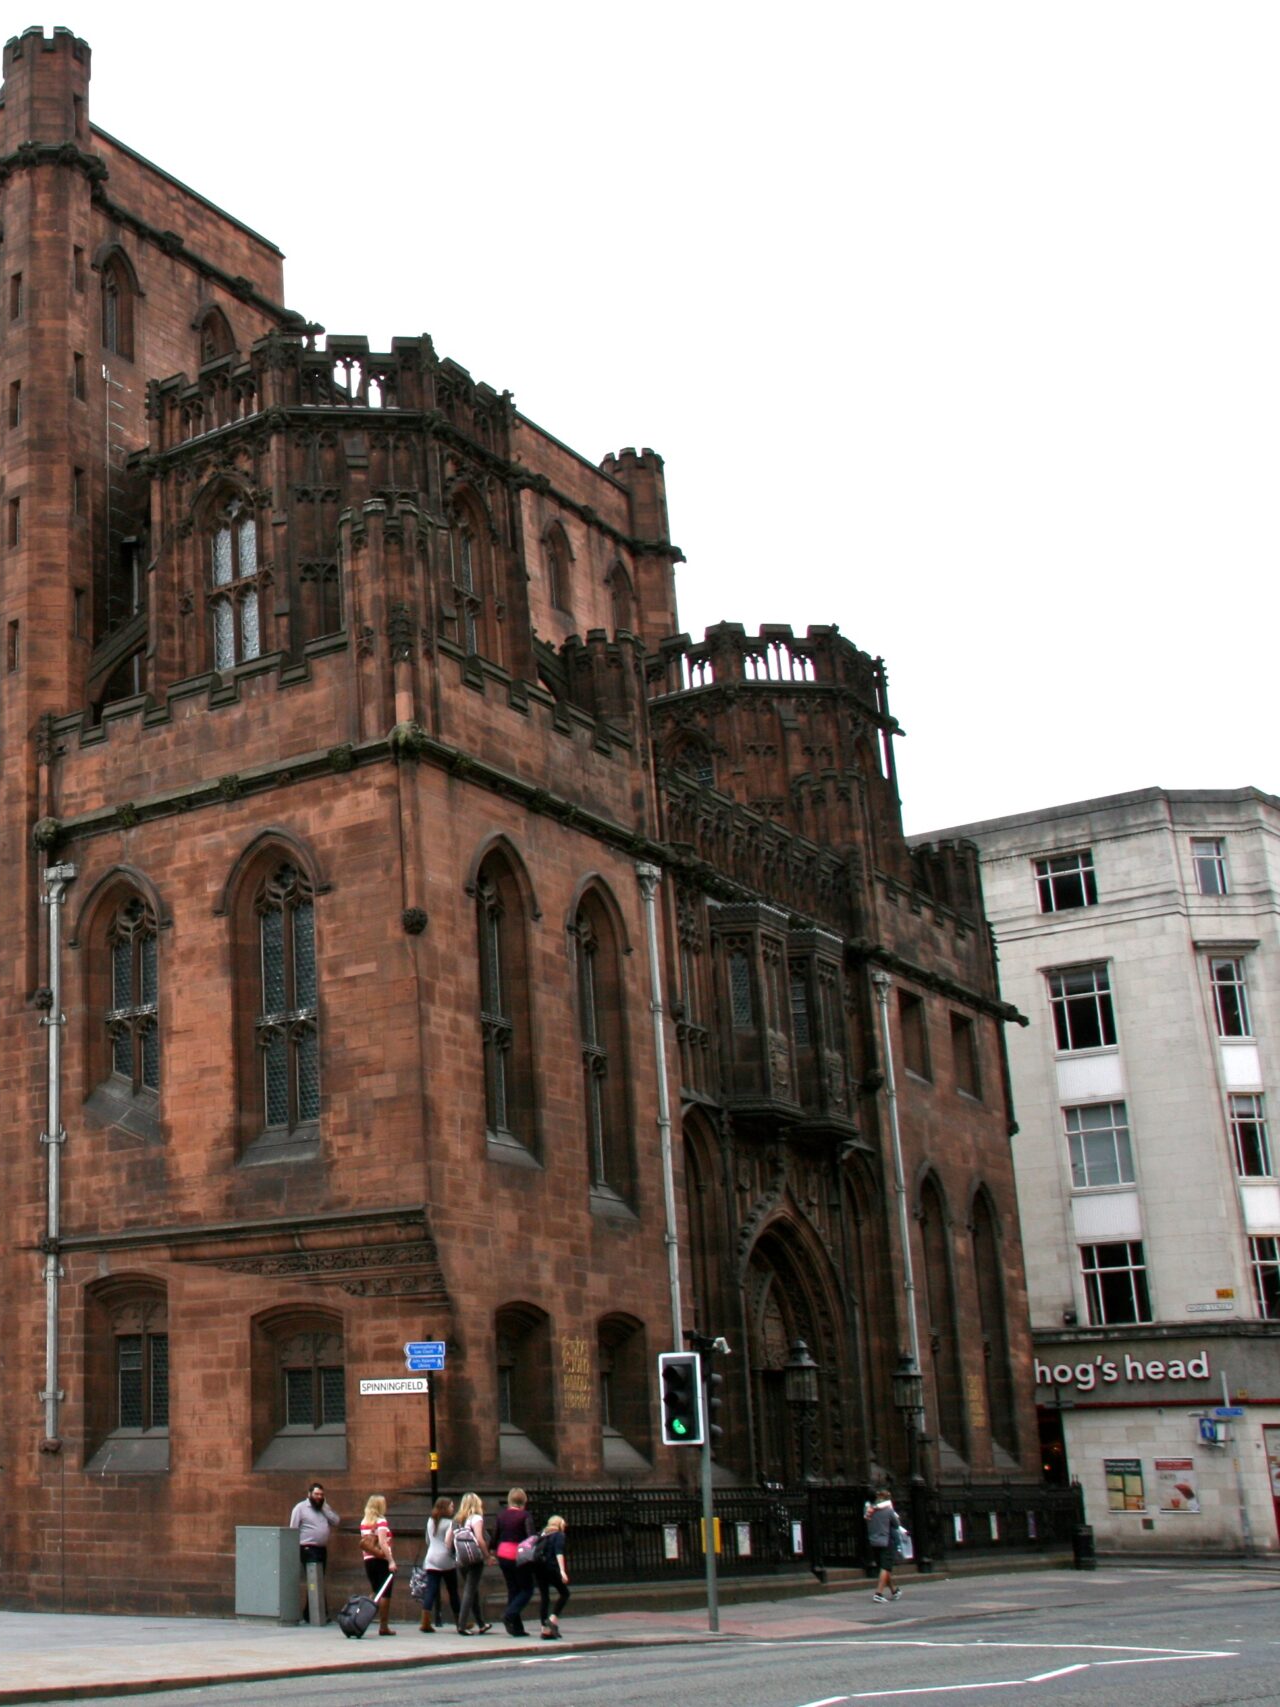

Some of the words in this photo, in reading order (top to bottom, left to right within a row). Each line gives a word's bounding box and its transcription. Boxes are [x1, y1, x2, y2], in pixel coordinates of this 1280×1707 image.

[1034, 1355, 1118, 1391] hog's
[1124, 1350, 1210, 1381] head
[362, 1380, 423, 1392] SPINNINGFIELD
